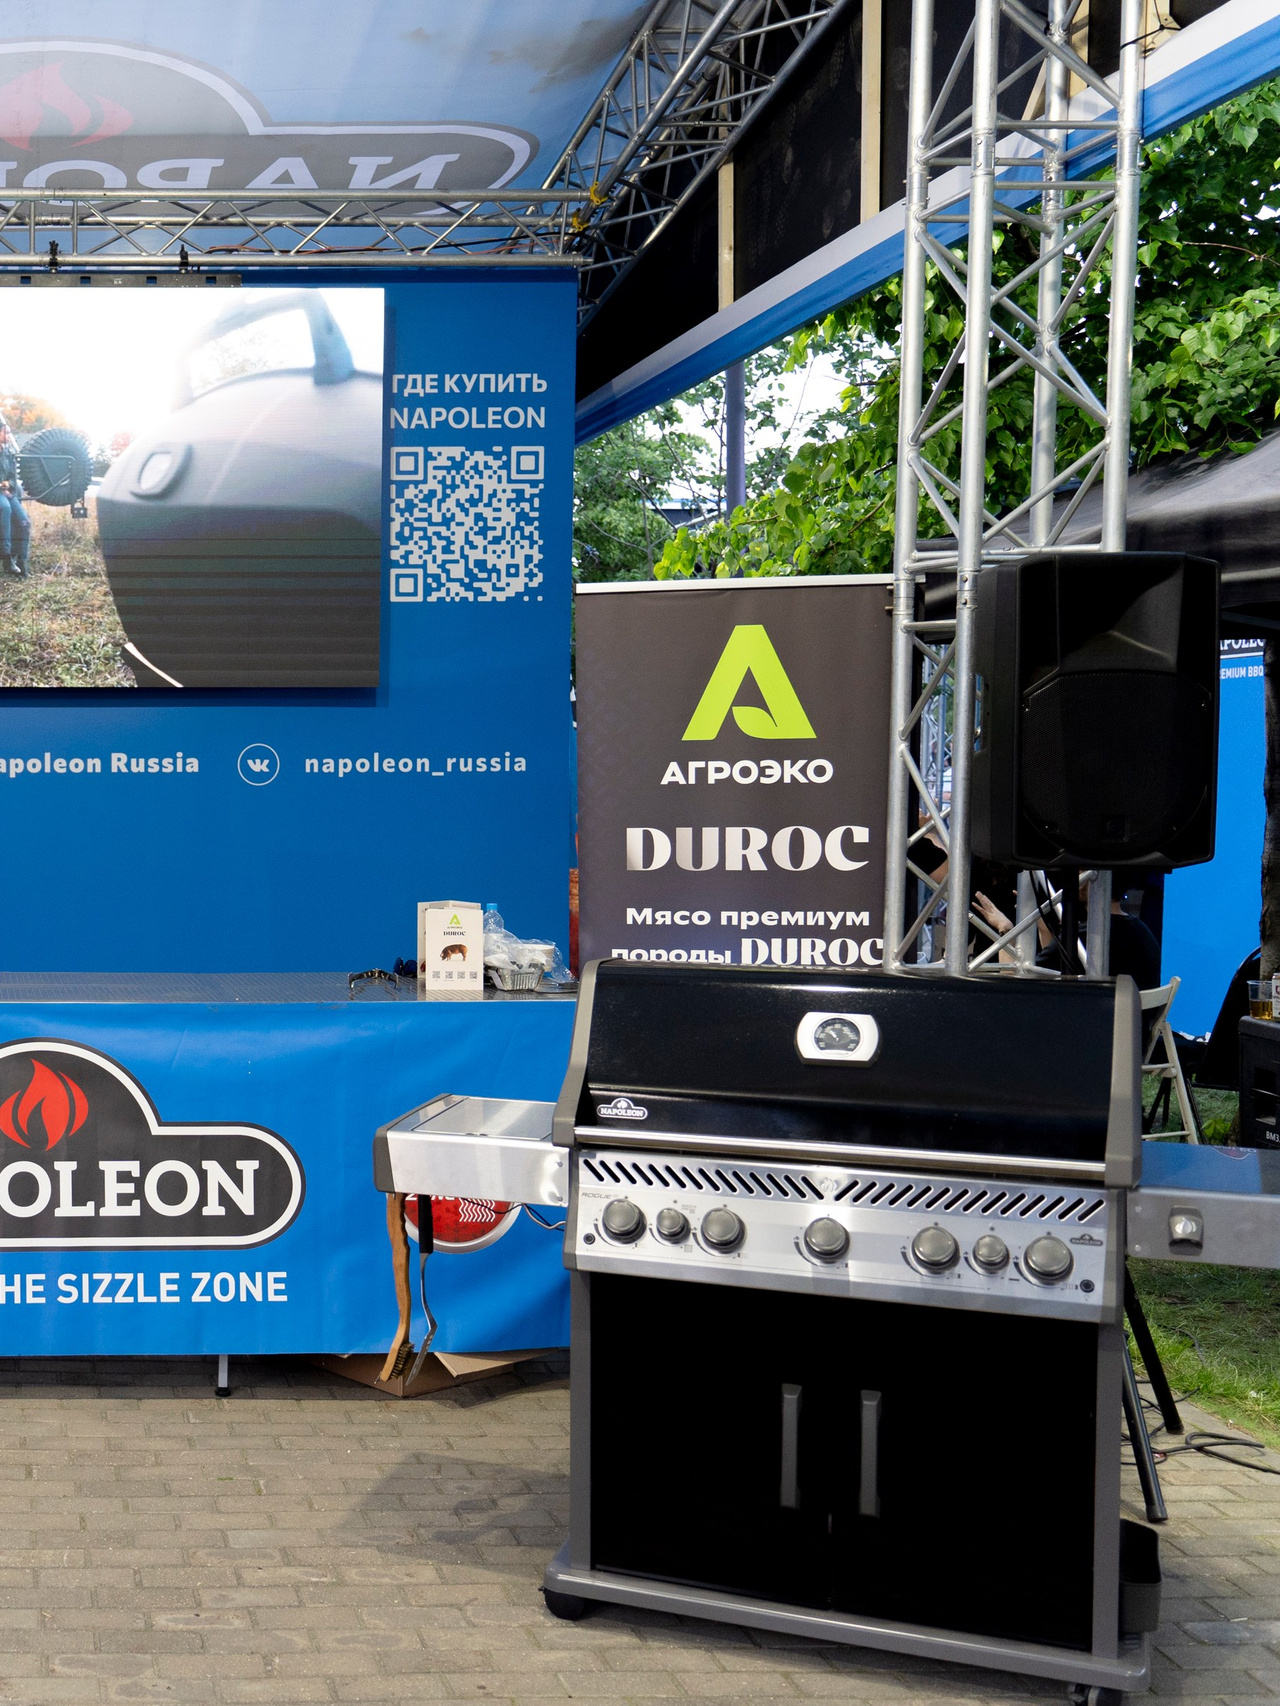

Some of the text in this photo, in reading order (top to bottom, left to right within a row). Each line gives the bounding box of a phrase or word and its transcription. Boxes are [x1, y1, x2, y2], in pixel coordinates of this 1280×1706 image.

[392, 373, 548, 397] ГДЕ КУПИТЬ
[390, 406, 546, 429] NAPOLEON
[1220, 666, 1264, 679] EMIUM BBQ
[111, 752, 199, 773] Russia
[305, 752, 527, 778] napoleon_russia
[660, 758, 834, 785] АГРОЭКО
[626, 825, 869, 871] DUROC
[626, 907, 870, 930] Мясо премиум
[740, 938, 883, 966] DUROC
[600, 1107, 644, 1118] NAPOLEON
[581, 1192, 612, 1200] ROGUE
[57, 1273, 181, 1303] SIZZLE
[191, 1272, 288, 1302] ZONE
